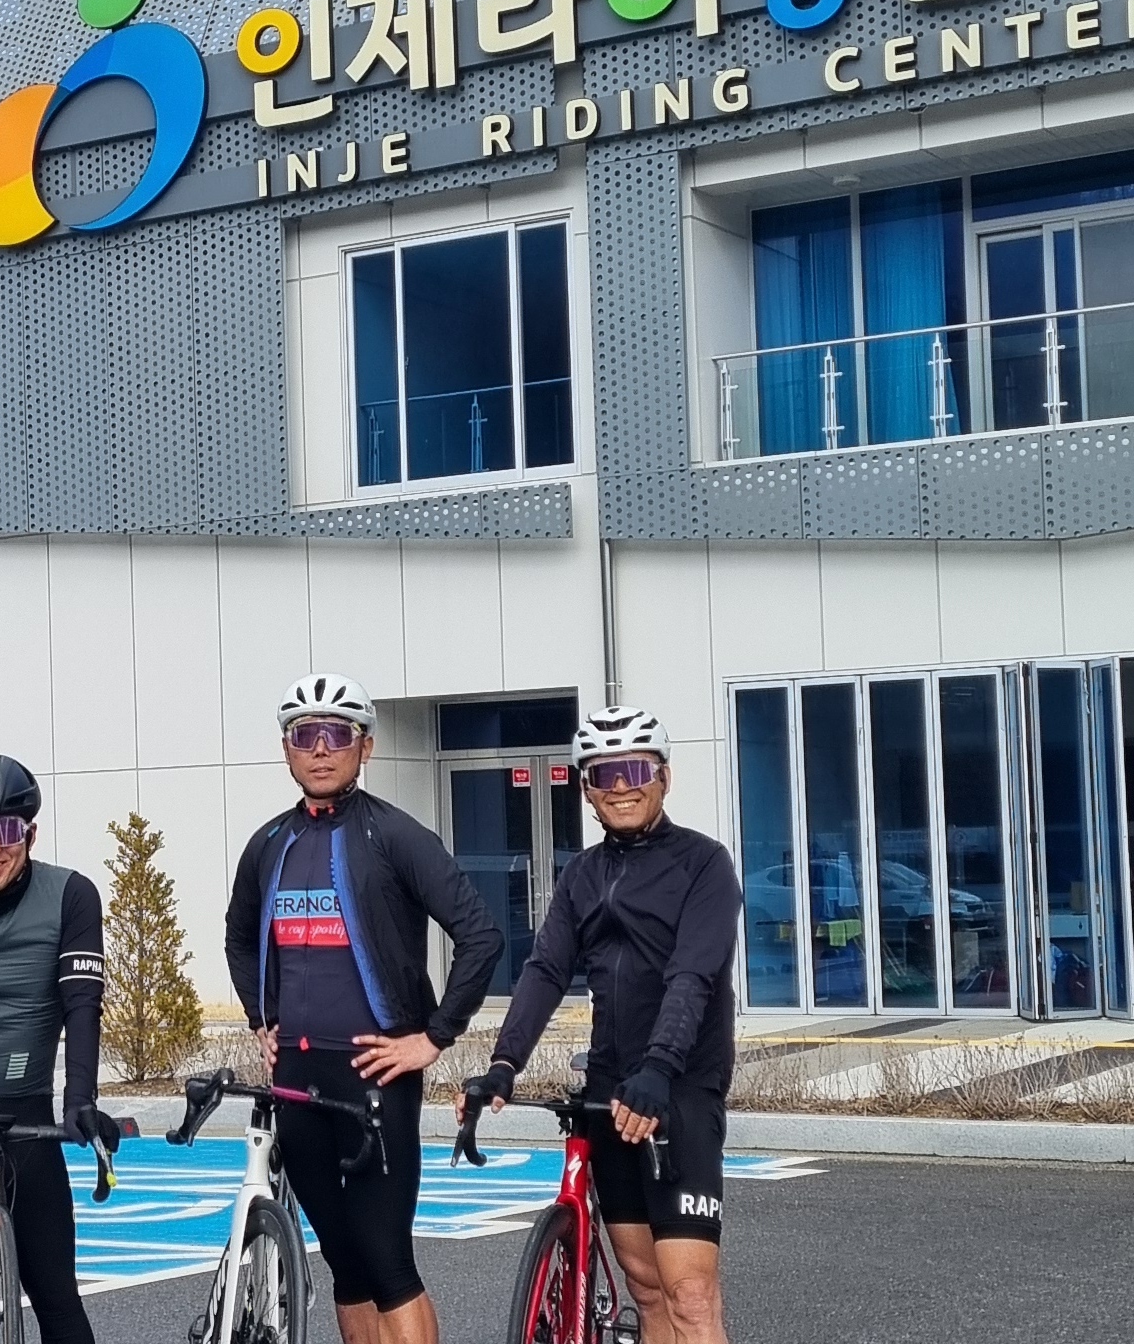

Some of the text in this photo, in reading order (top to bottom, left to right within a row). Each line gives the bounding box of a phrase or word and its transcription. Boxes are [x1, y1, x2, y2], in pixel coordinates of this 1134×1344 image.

[256, 133, 411, 198] INJE
[482, 67, 752, 157] RIDING
[73, 959, 103, 973] RAPHA
